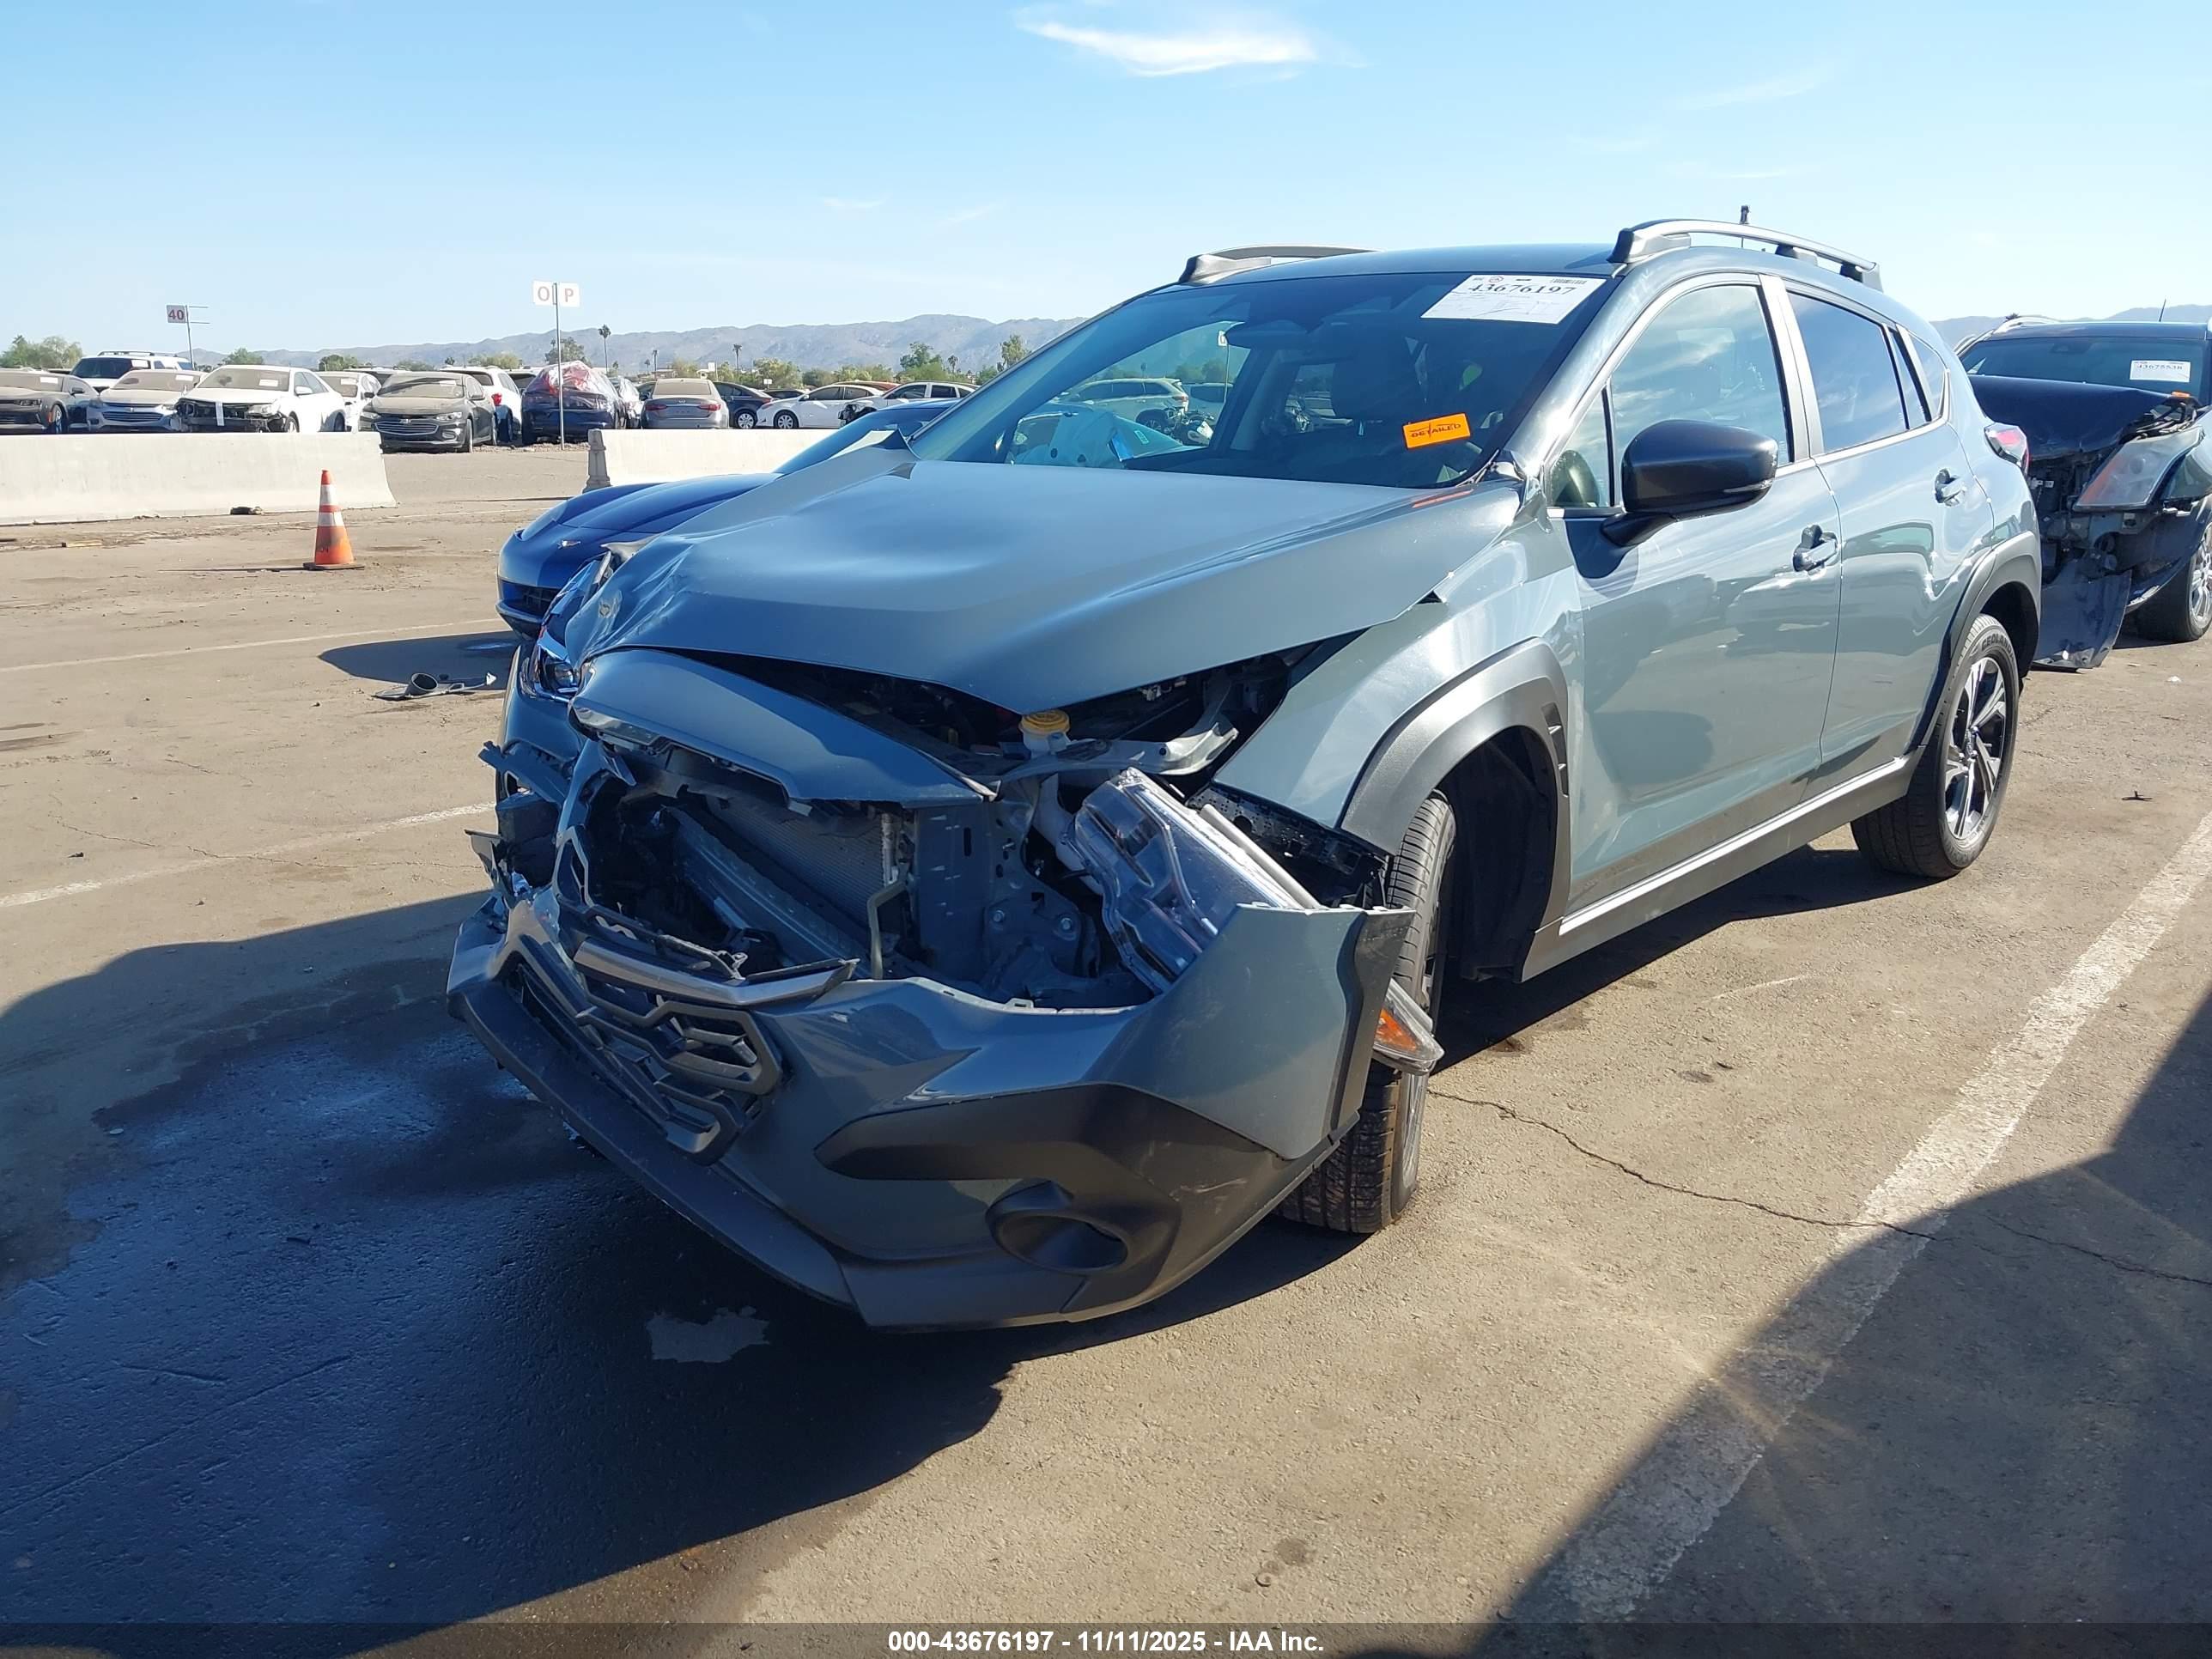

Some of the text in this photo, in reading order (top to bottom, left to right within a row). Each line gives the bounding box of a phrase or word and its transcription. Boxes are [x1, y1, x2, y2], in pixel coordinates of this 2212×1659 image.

[538, 286, 550, 301] O
[564, 288, 574, 303] P
[1467, 283, 1577, 295] 43676197
[167, 309, 185, 320] 40
